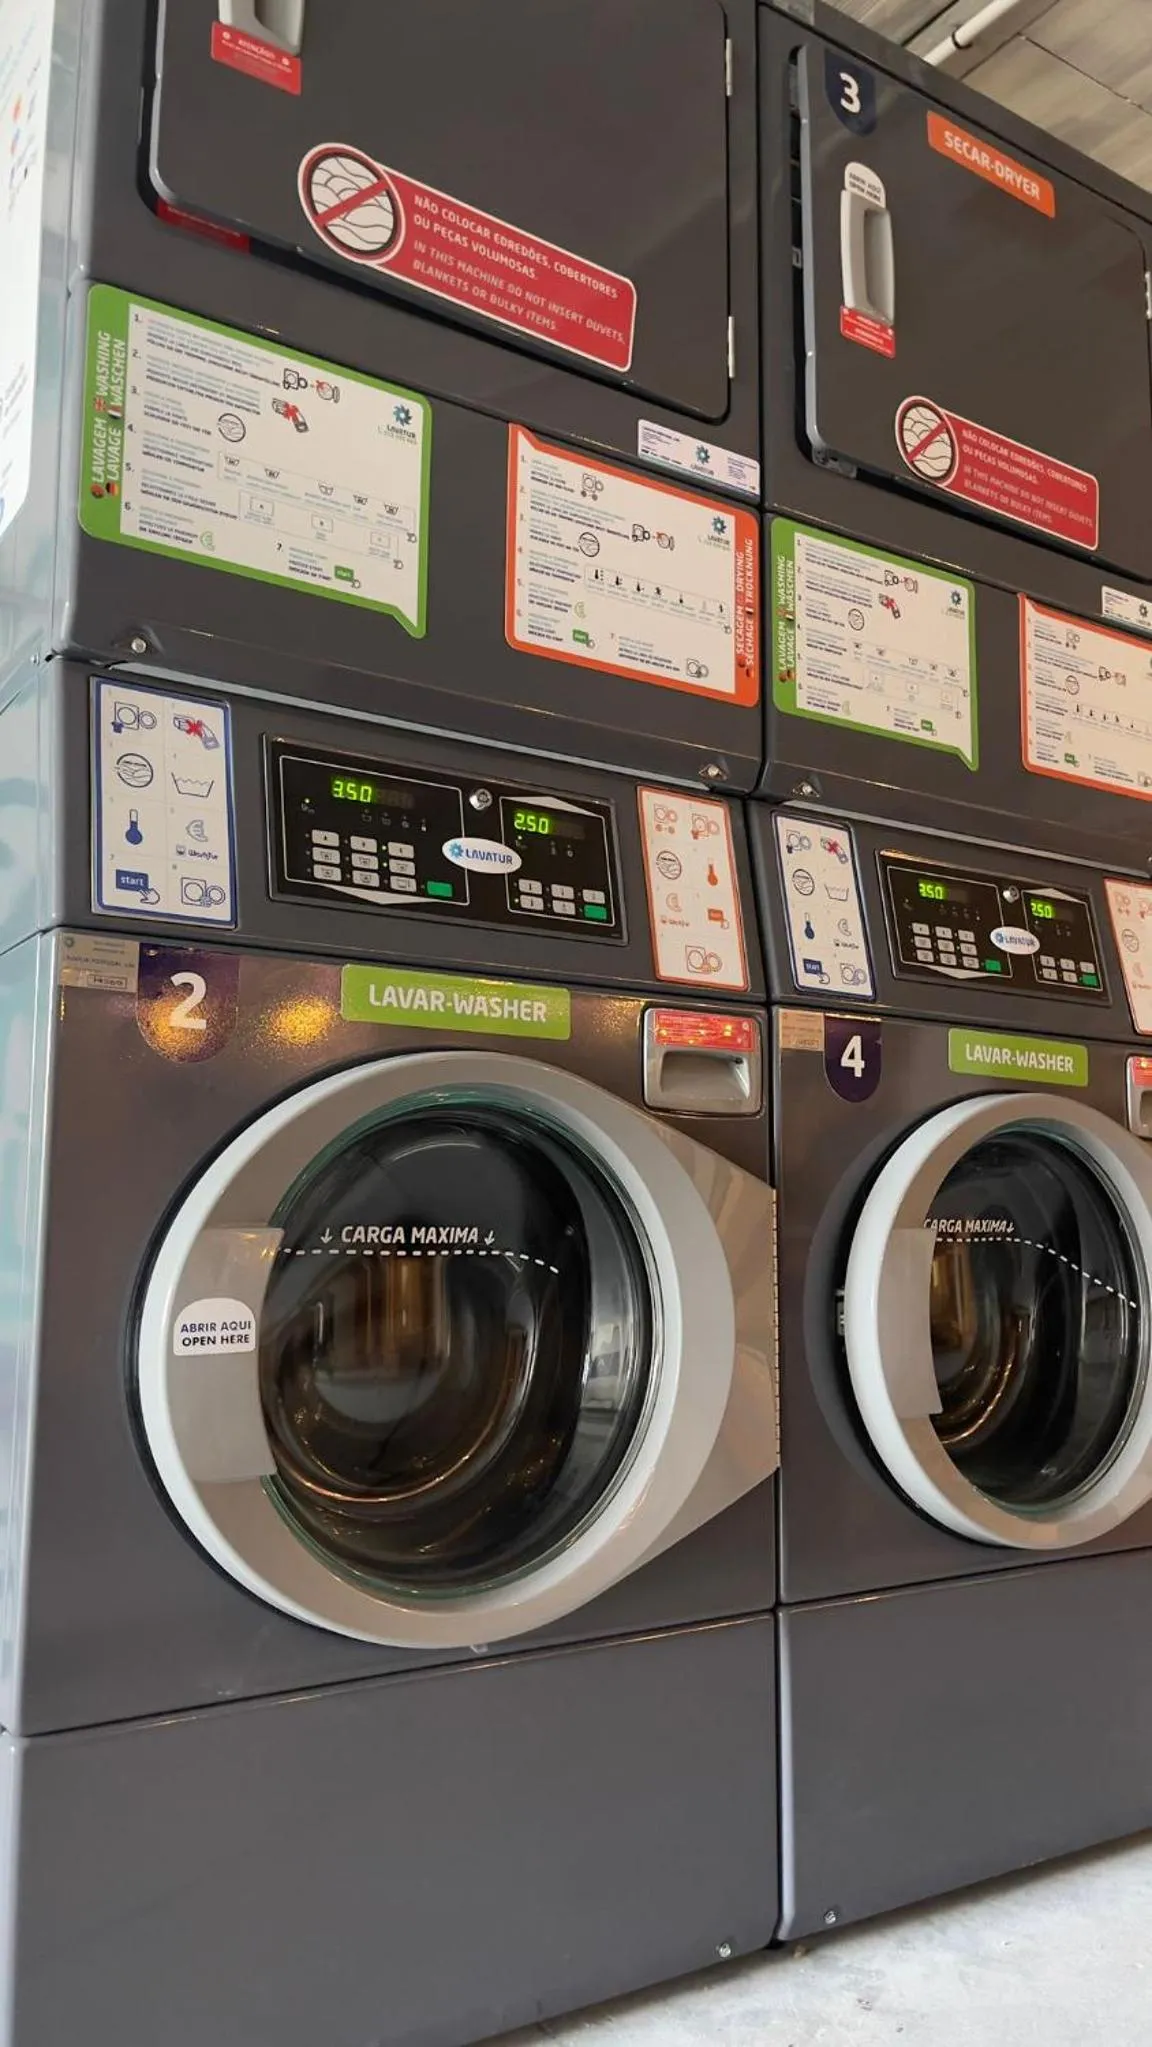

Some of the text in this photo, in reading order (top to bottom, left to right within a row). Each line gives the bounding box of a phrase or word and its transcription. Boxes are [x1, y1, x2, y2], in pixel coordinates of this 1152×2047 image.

[840, 72, 861, 114] 3
[943, 131, 1041, 201] SECAR-DRYER
[413, 214, 431, 229] OU
[433, 223, 469, 249] PEÇAS
[414, 194, 619, 299] NÃO COLOCAR EDREDÕES, COBERTORES
[412, 259, 469, 292] BLANKETS
[472, 285, 488, 300] OR
[489, 293, 525, 317] BULKY
[414, 240, 626, 345] IN THIS MACHINE DO NOT INSERT DUVETS,
[92, 330, 111, 483] LAVAGEM WASHING
[107, 427, 122, 481] LAVAGE
[745, 538, 754, 604] TROCKNUNG
[736, 552, 745, 655] SECAGEM DRYING
[778, 555, 786, 671] LAVAGEM WASHING
[787, 628, 795, 668] LAVAGE
[514, 813, 549, 834] 2.50
[465, 848, 513, 865] LAVATUR
[120, 875, 145, 887] start
[170, 971, 207, 1030] 2
[369, 983, 547, 1023] LAVAR-WASHER
[840, 1035, 865, 1078] 4
[965, 1043, 1074, 1074] LAVAR-WASHER
[341, 1226, 479, 1244] CARGA MAXIMA
[923, 1218, 1007, 1233] CARGA MAXIMA
[181, 1320, 252, 1334] ABRIR AQUI
[182, 1334, 250, 1347] OPEN HERE
